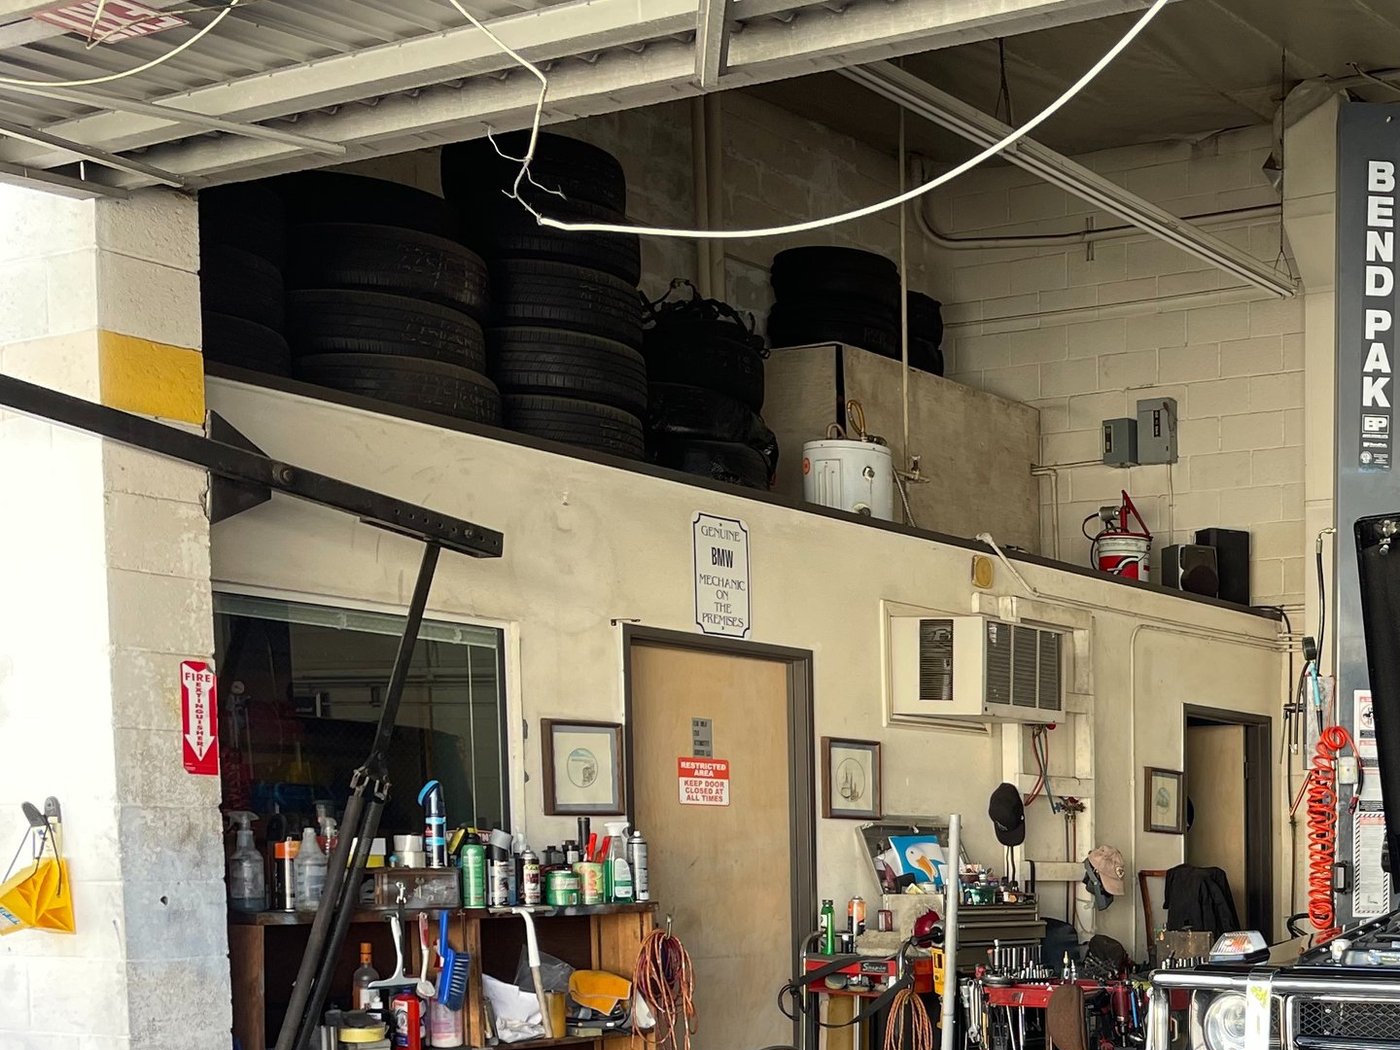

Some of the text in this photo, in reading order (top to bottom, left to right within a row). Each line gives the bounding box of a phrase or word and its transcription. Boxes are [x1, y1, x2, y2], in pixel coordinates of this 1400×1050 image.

[701, 525, 741, 542] GENUINE
[711, 546, 733, 569] BMW
[699, 573, 746, 592] MECHANIC
[715, 589, 729, 600] ON
[714, 601, 732, 614] THE
[702, 612, 744, 628] PREMISES
[185, 672, 211, 683] FIRE
[680, 761, 727, 771] RESTRICTED
[693, 769, 714, 777] AREA
[704, 780, 725, 788] DOOR
[685, 787, 713, 795] CLOSED
[686, 794, 701, 802] ALL
